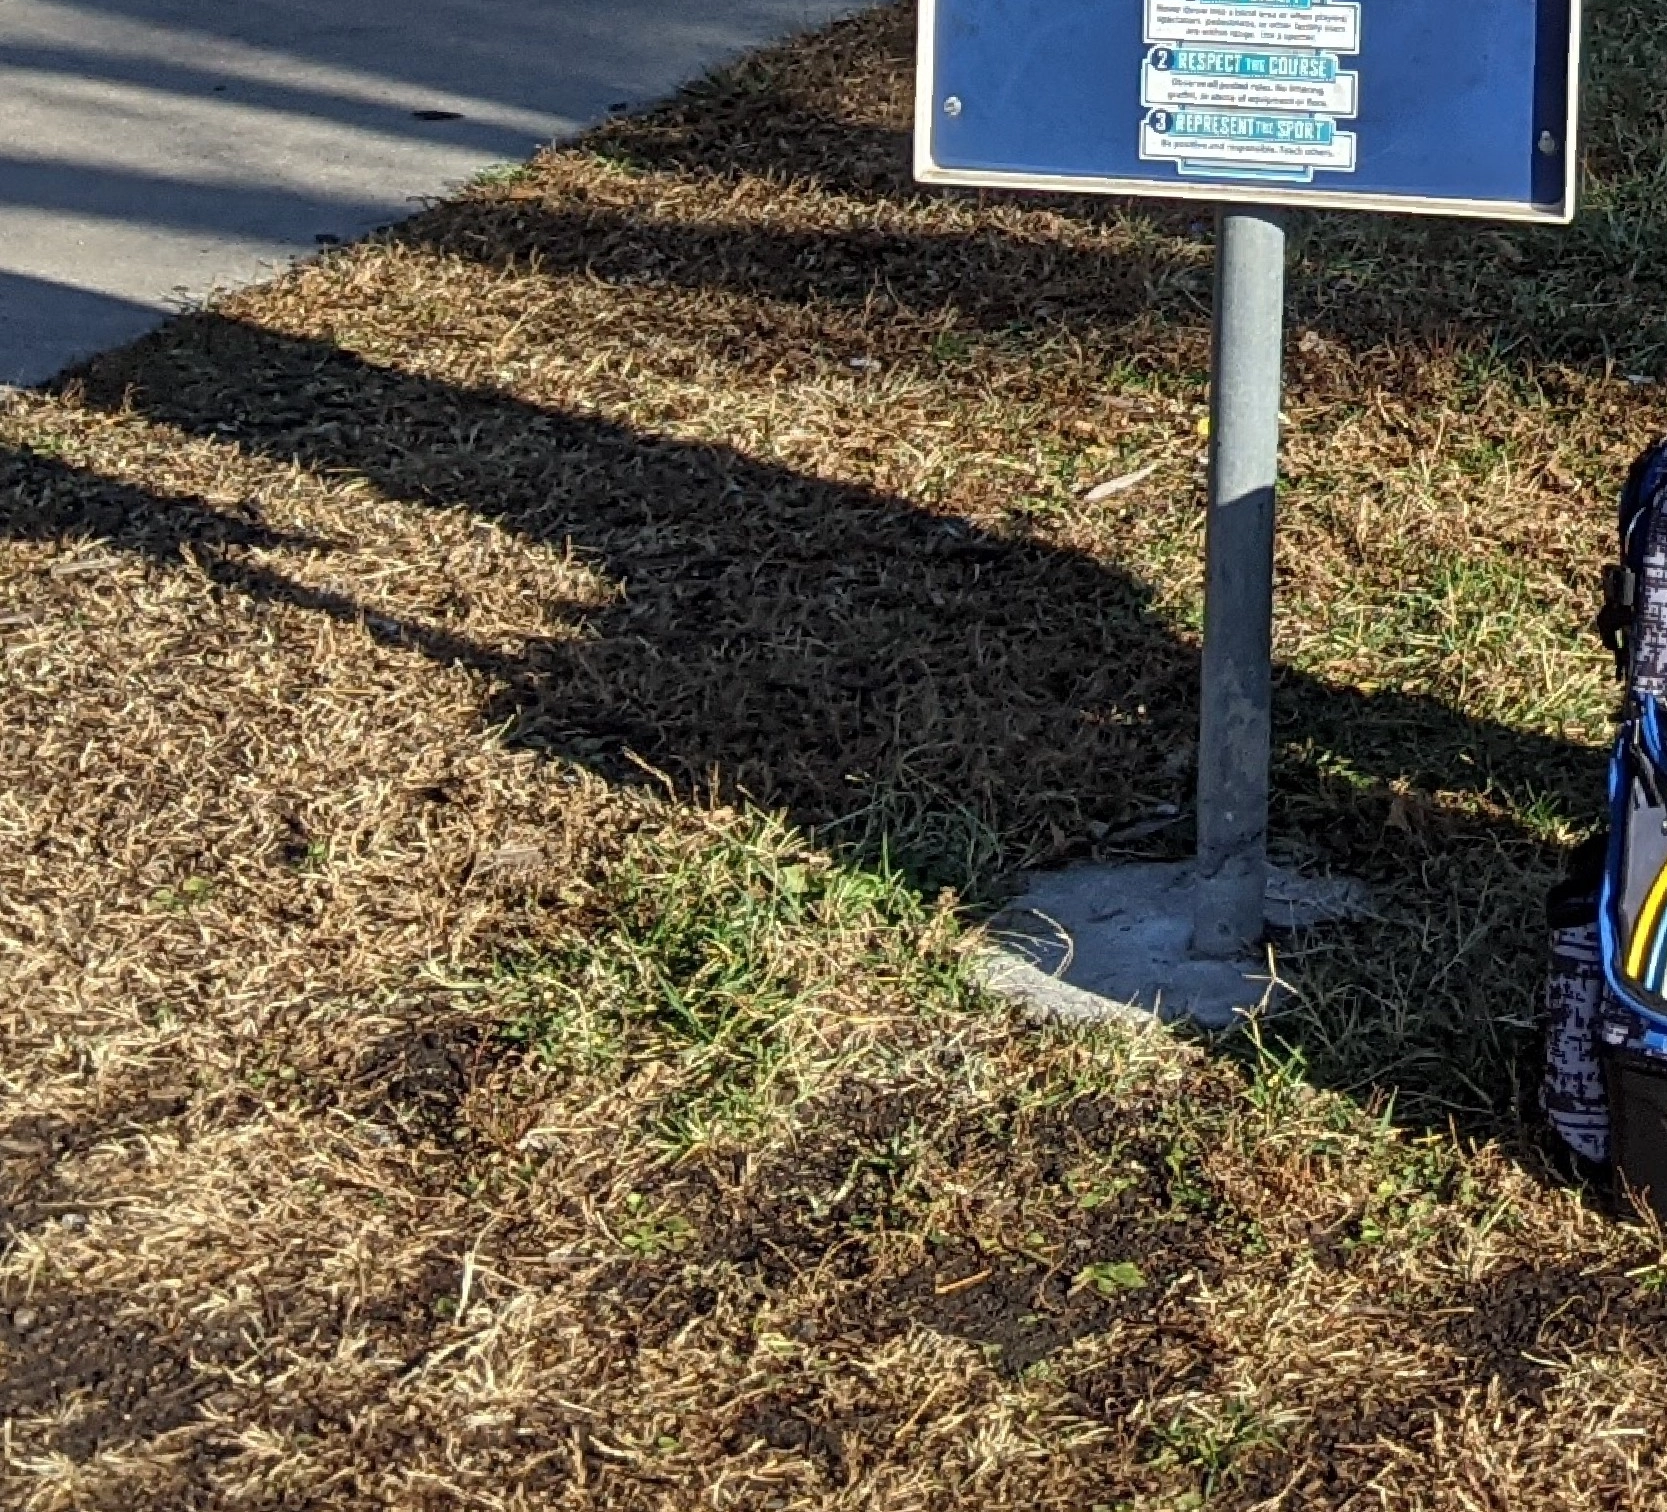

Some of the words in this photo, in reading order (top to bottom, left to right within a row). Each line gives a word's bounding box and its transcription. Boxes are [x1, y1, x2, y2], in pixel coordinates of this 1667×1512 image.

[1157, 50, 1169, 69] 2
[1178, 51, 1243, 73] RESPECT
[1269, 57, 1328, 79] COURSE
[1155, 113, 1168, 134] 3
[1175, 114, 1254, 136] REPRESENT
[1277, 121, 1325, 142] SPORT
